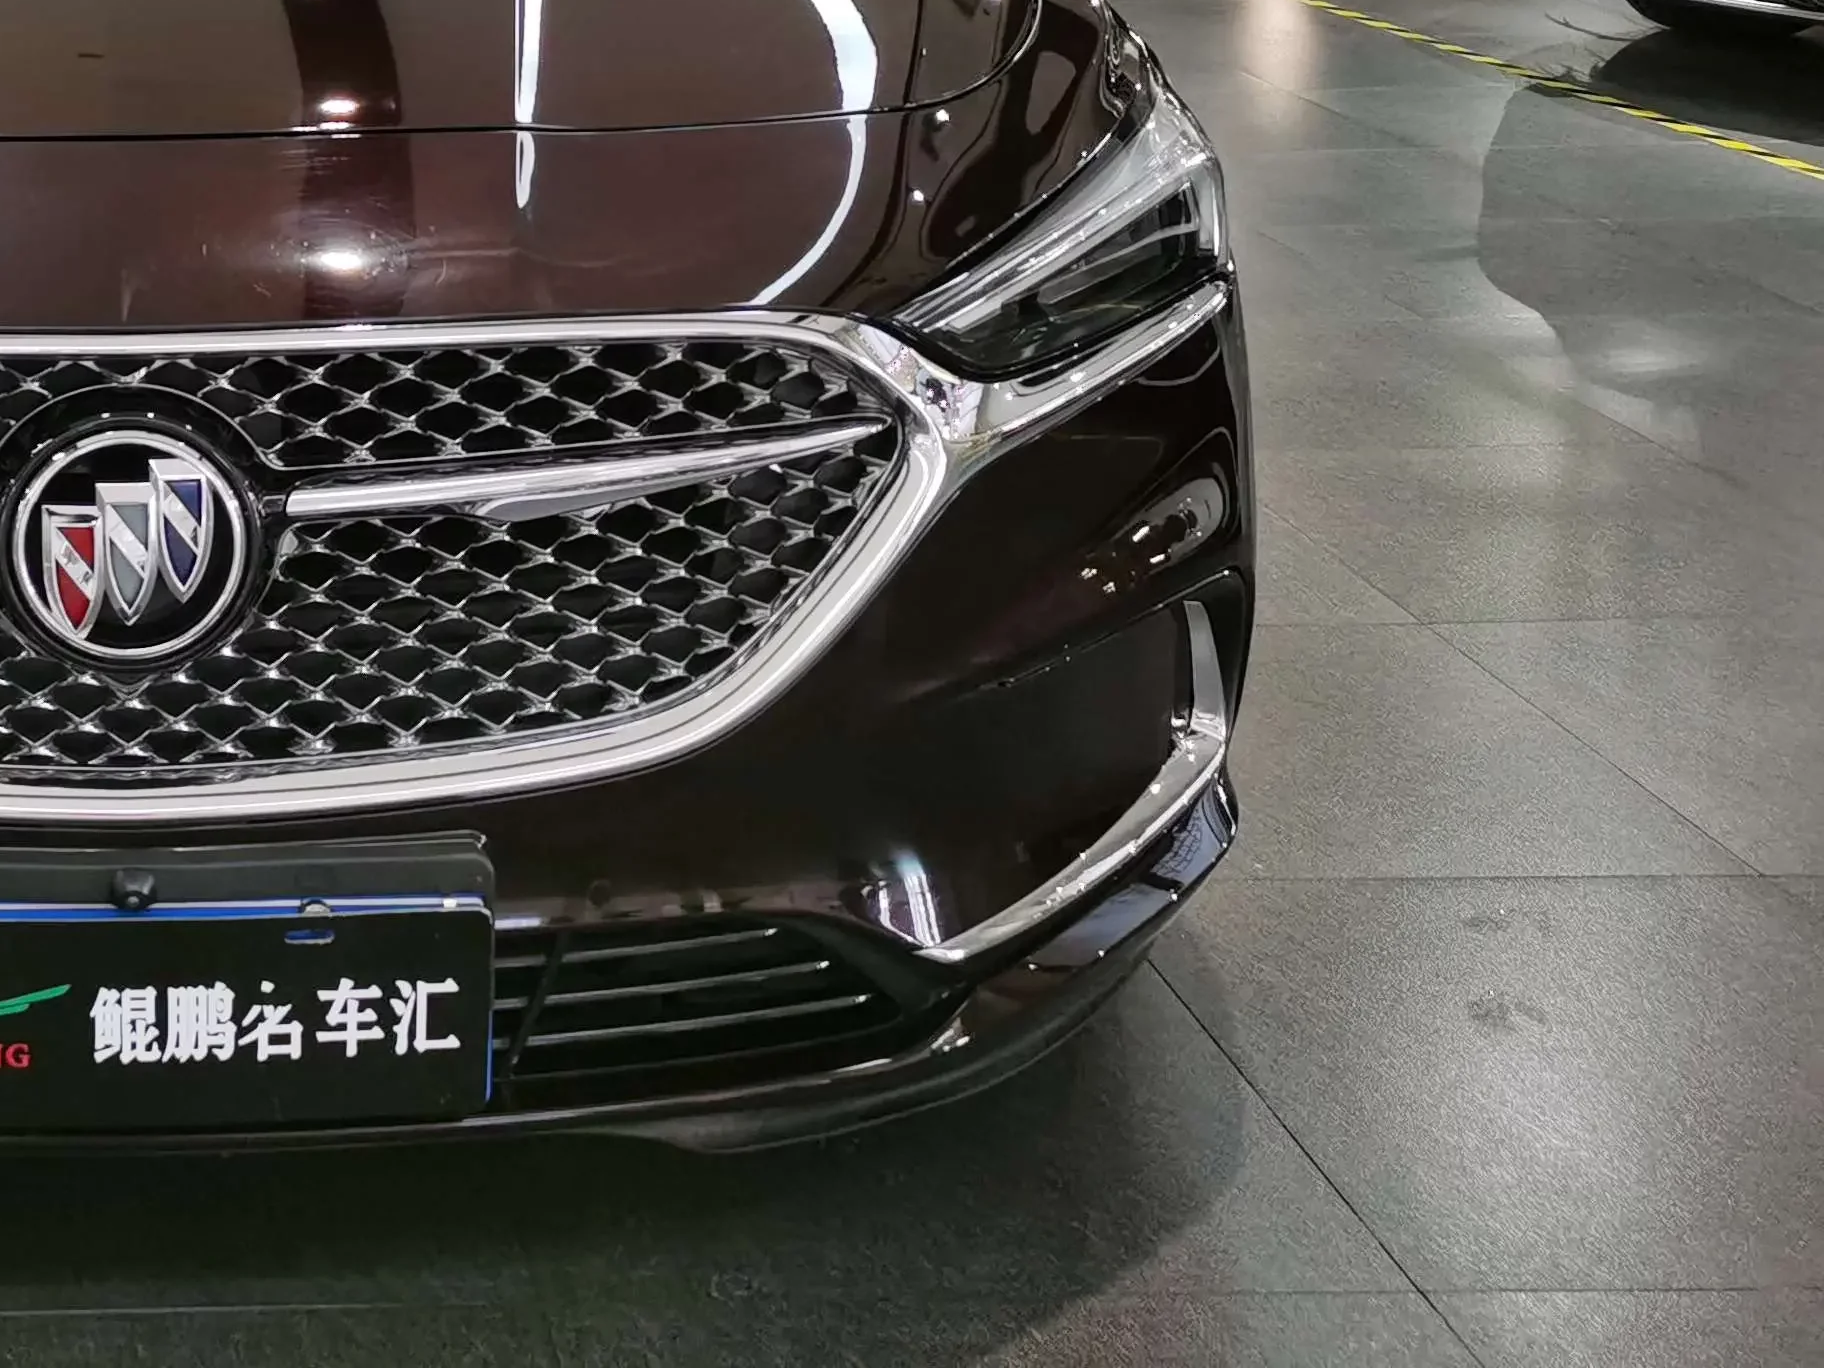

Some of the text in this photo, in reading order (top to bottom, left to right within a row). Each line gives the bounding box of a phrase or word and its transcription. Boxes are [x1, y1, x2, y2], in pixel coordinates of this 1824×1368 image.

[89, 977, 461, 1066] 鲲鹏名车汇
